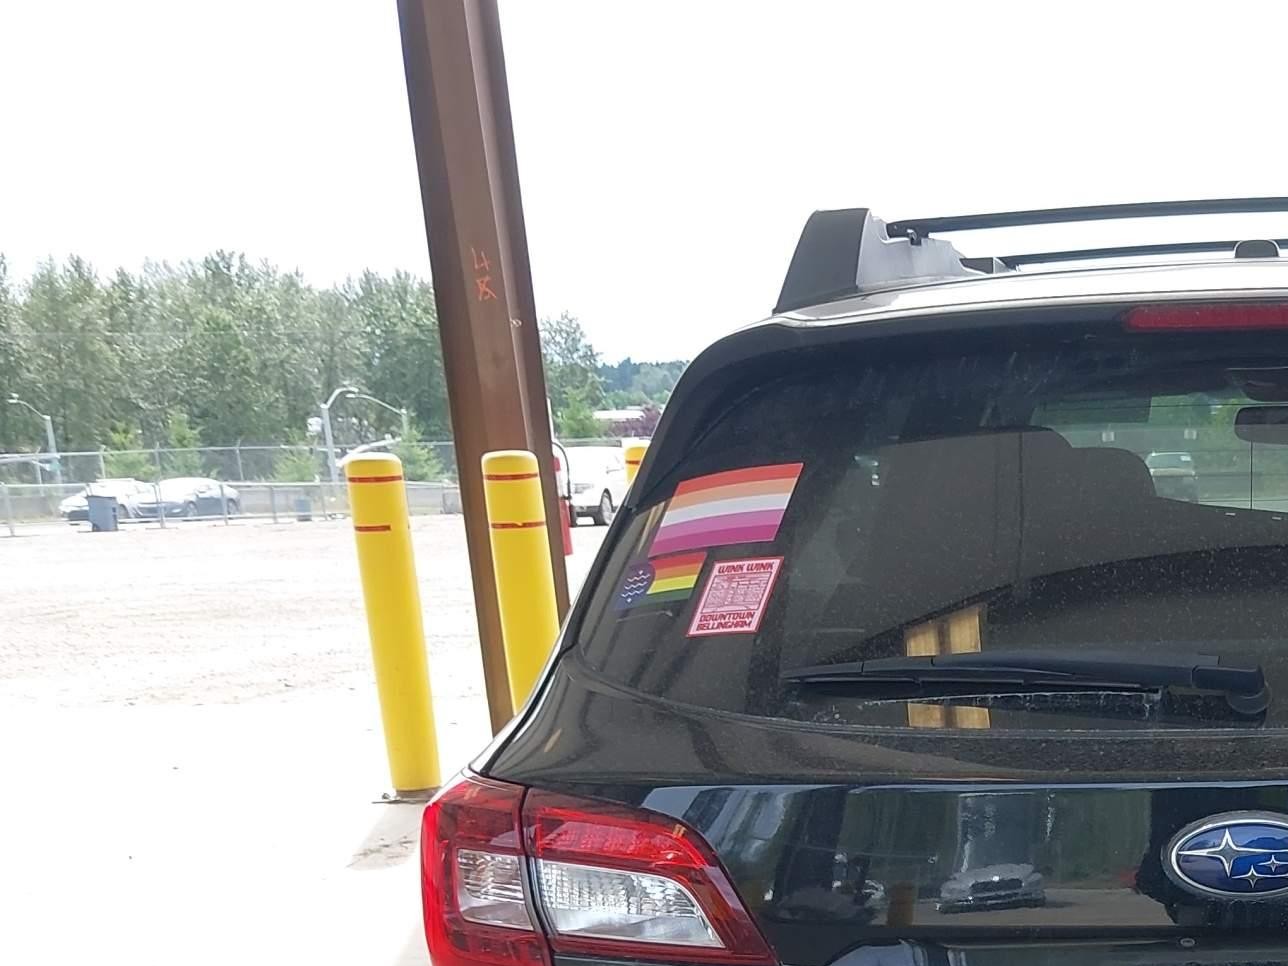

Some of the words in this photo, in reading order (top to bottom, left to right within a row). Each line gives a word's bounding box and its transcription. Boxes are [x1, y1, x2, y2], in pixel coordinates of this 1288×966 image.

[718, 563, 744, 574] WINK
[747, 561, 775, 572] WINK
[699, 611, 756, 623] DOWNTOWN
[696, 620, 753, 631] BELLINGHAM
